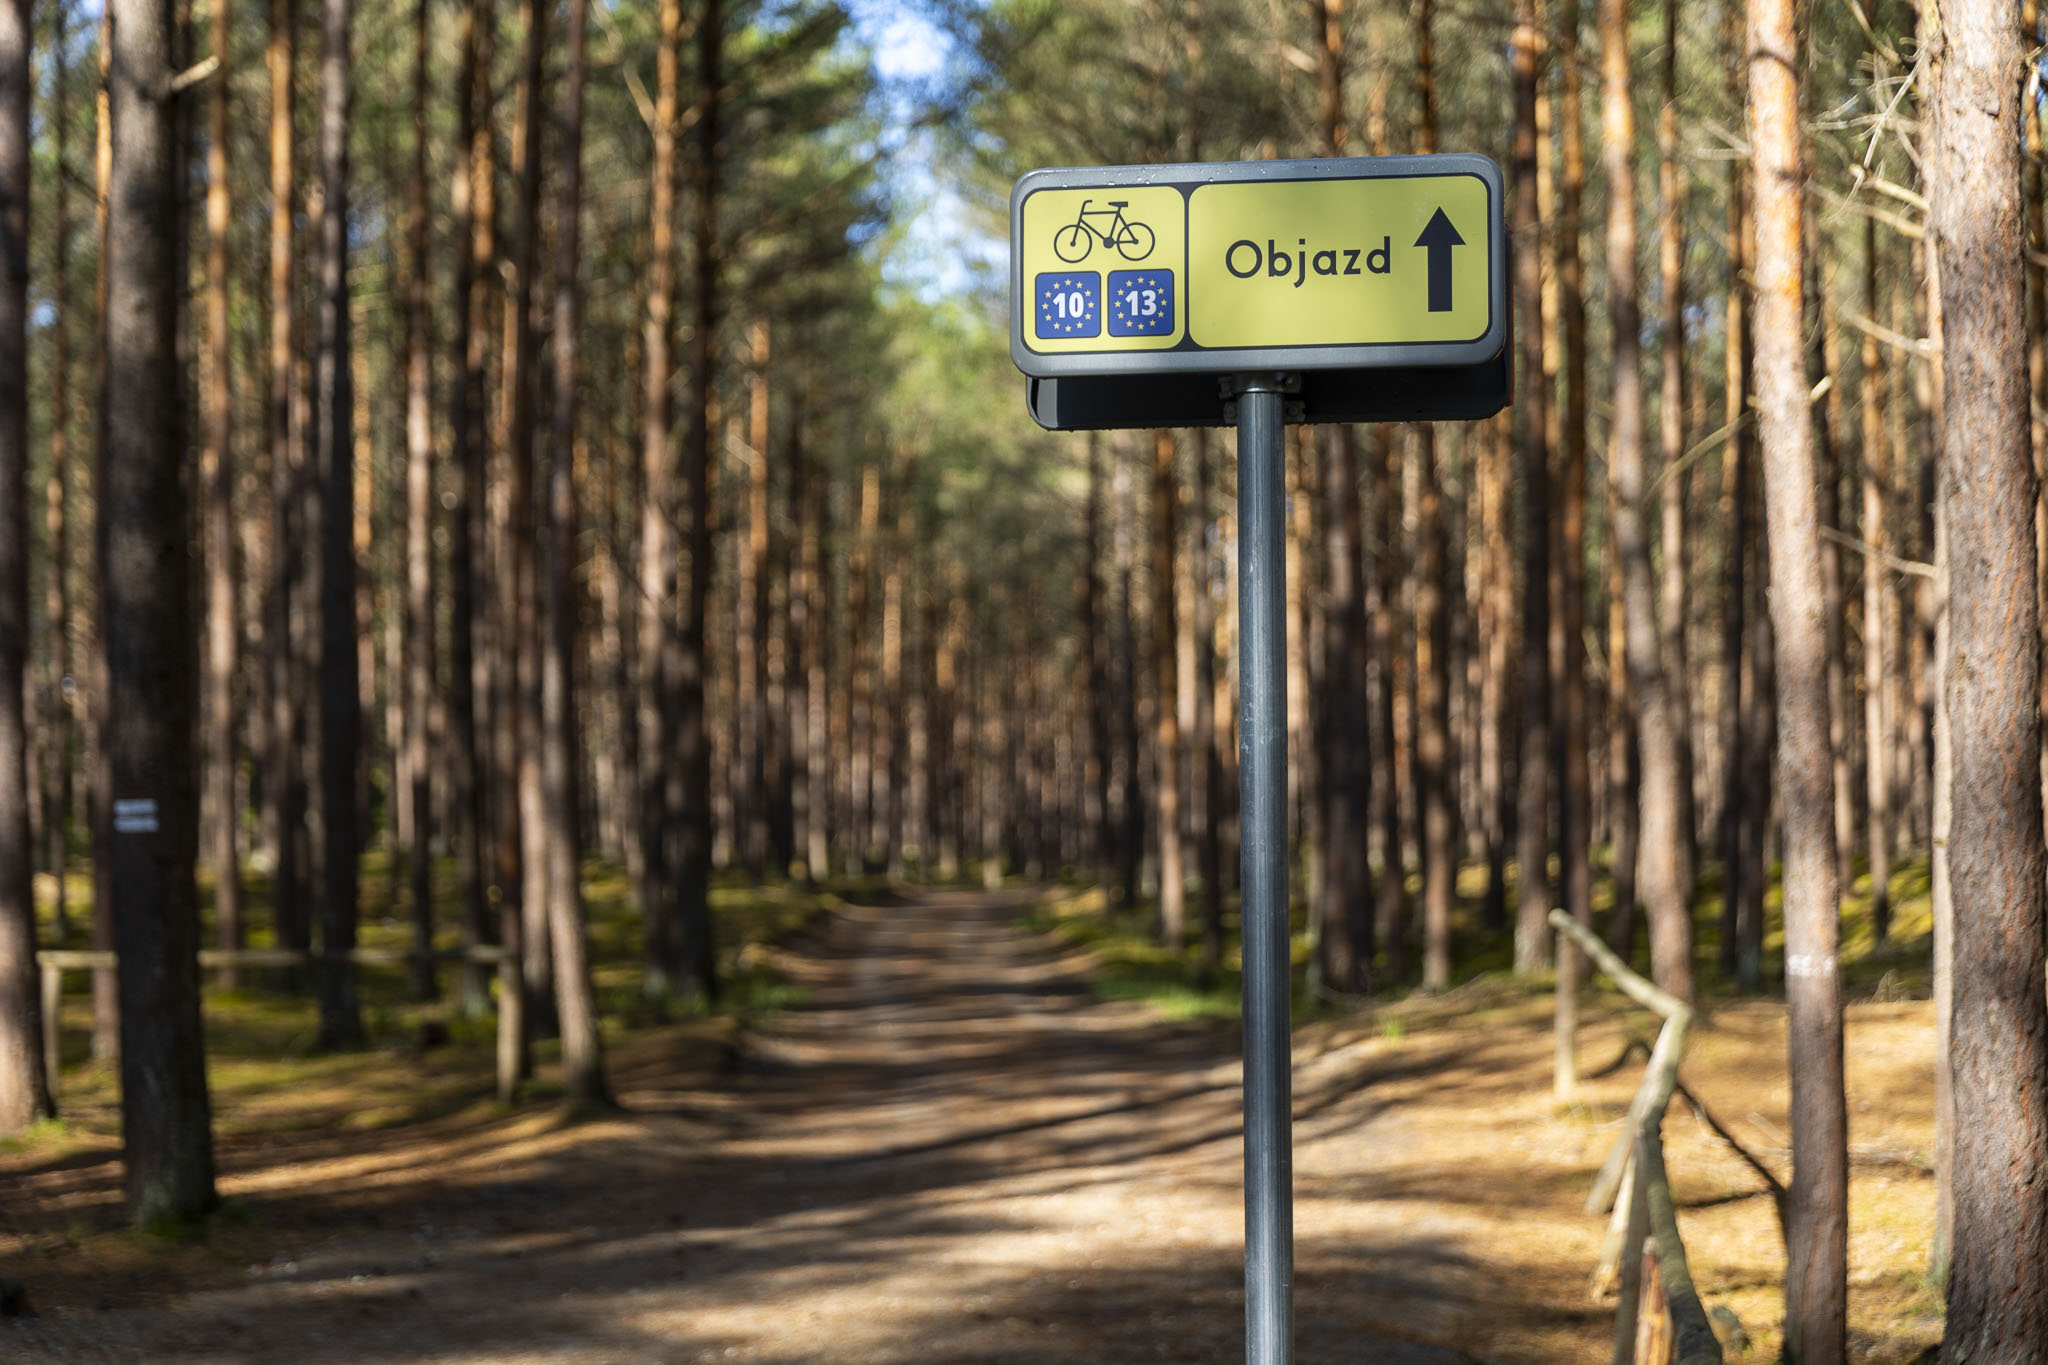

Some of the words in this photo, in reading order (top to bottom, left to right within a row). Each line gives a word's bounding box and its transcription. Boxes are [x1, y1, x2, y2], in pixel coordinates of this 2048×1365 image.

[1225, 236, 1391, 288] Objazd
[1053, 291, 1085, 318] 10
[1125, 289, 1157, 316] 13
